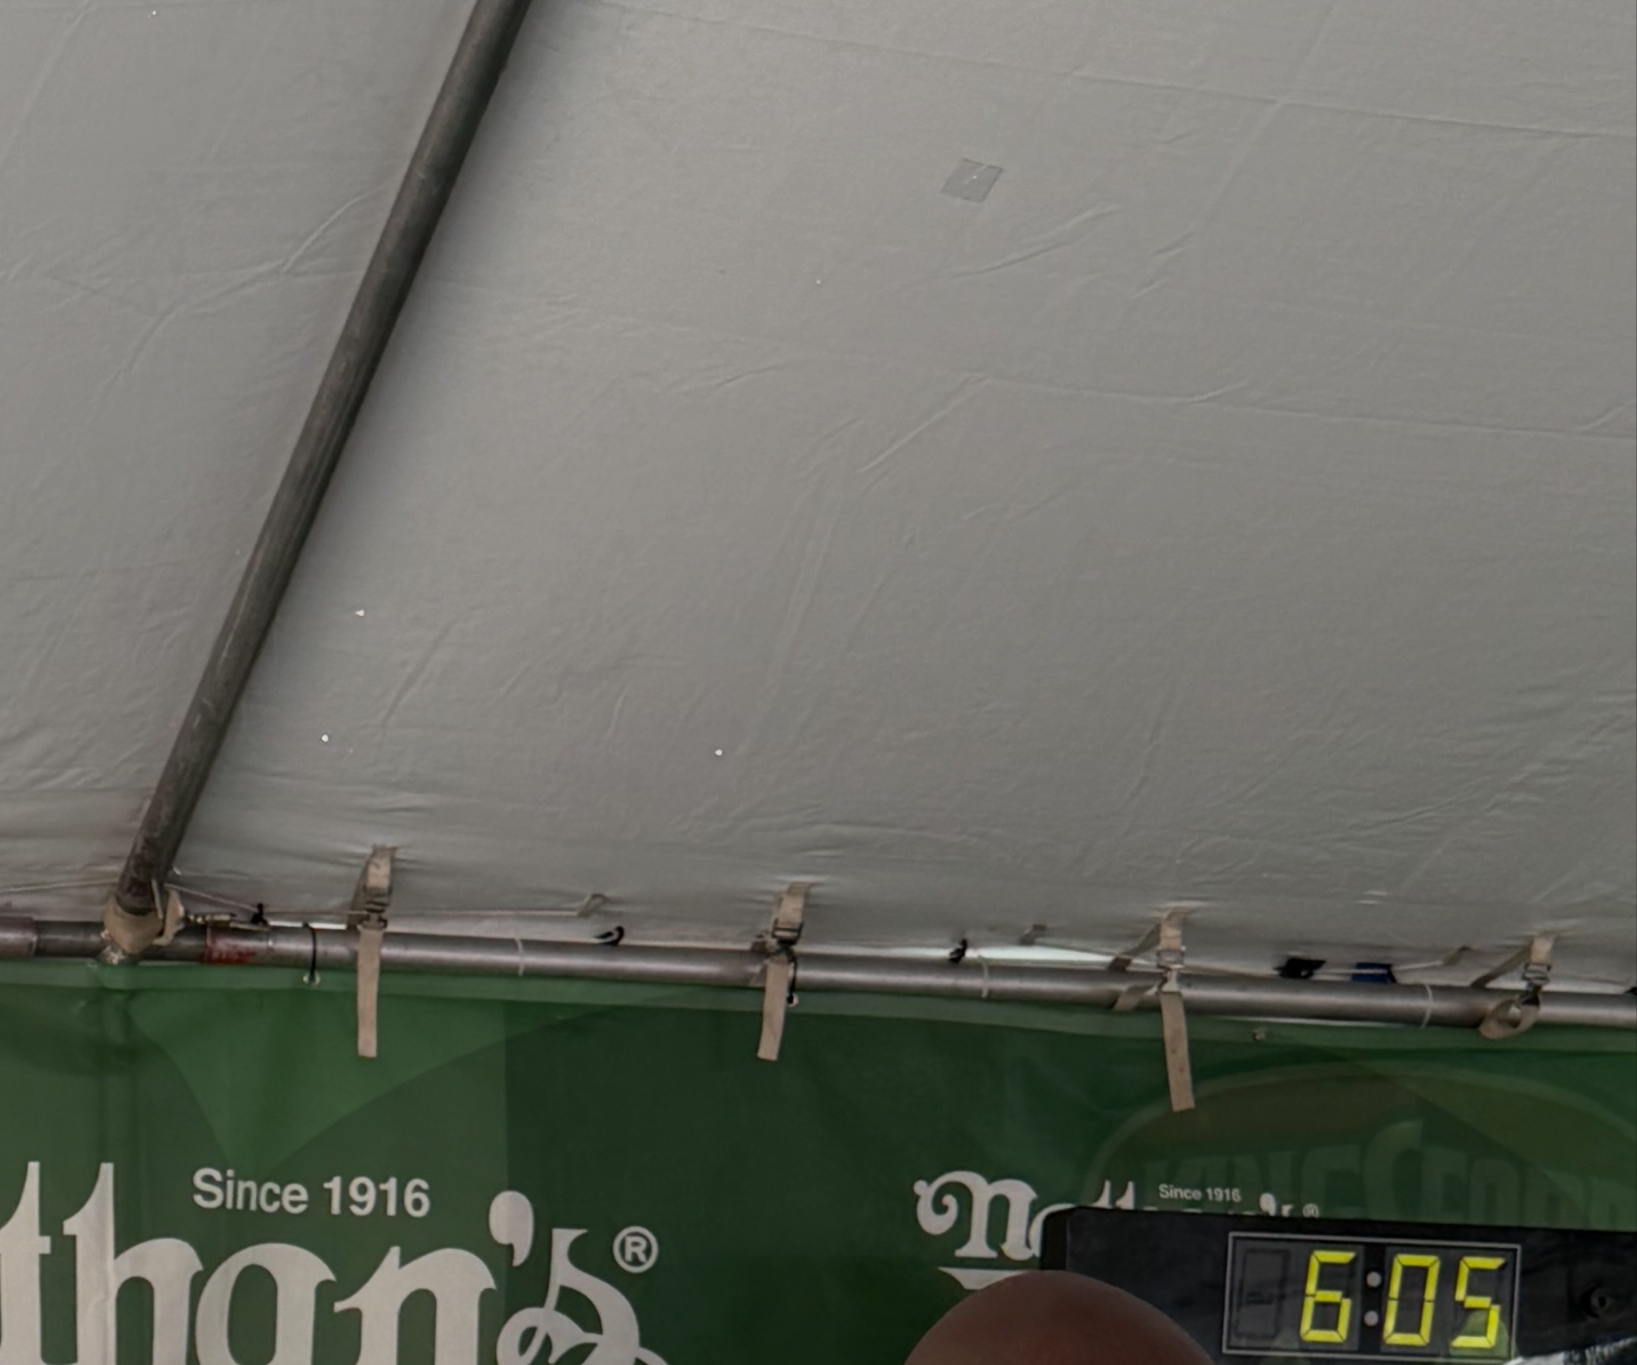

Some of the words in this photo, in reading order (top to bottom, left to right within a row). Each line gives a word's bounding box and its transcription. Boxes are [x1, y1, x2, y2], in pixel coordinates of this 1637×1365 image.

[192, 1167, 309, 1214] Since
[321, 1175, 432, 1219] 1916
[1158, 1184, 1202, 1201] Since
[1205, 1187, 1242, 1203] 1916
[1300, 1250, 1507, 1350] 6:05
